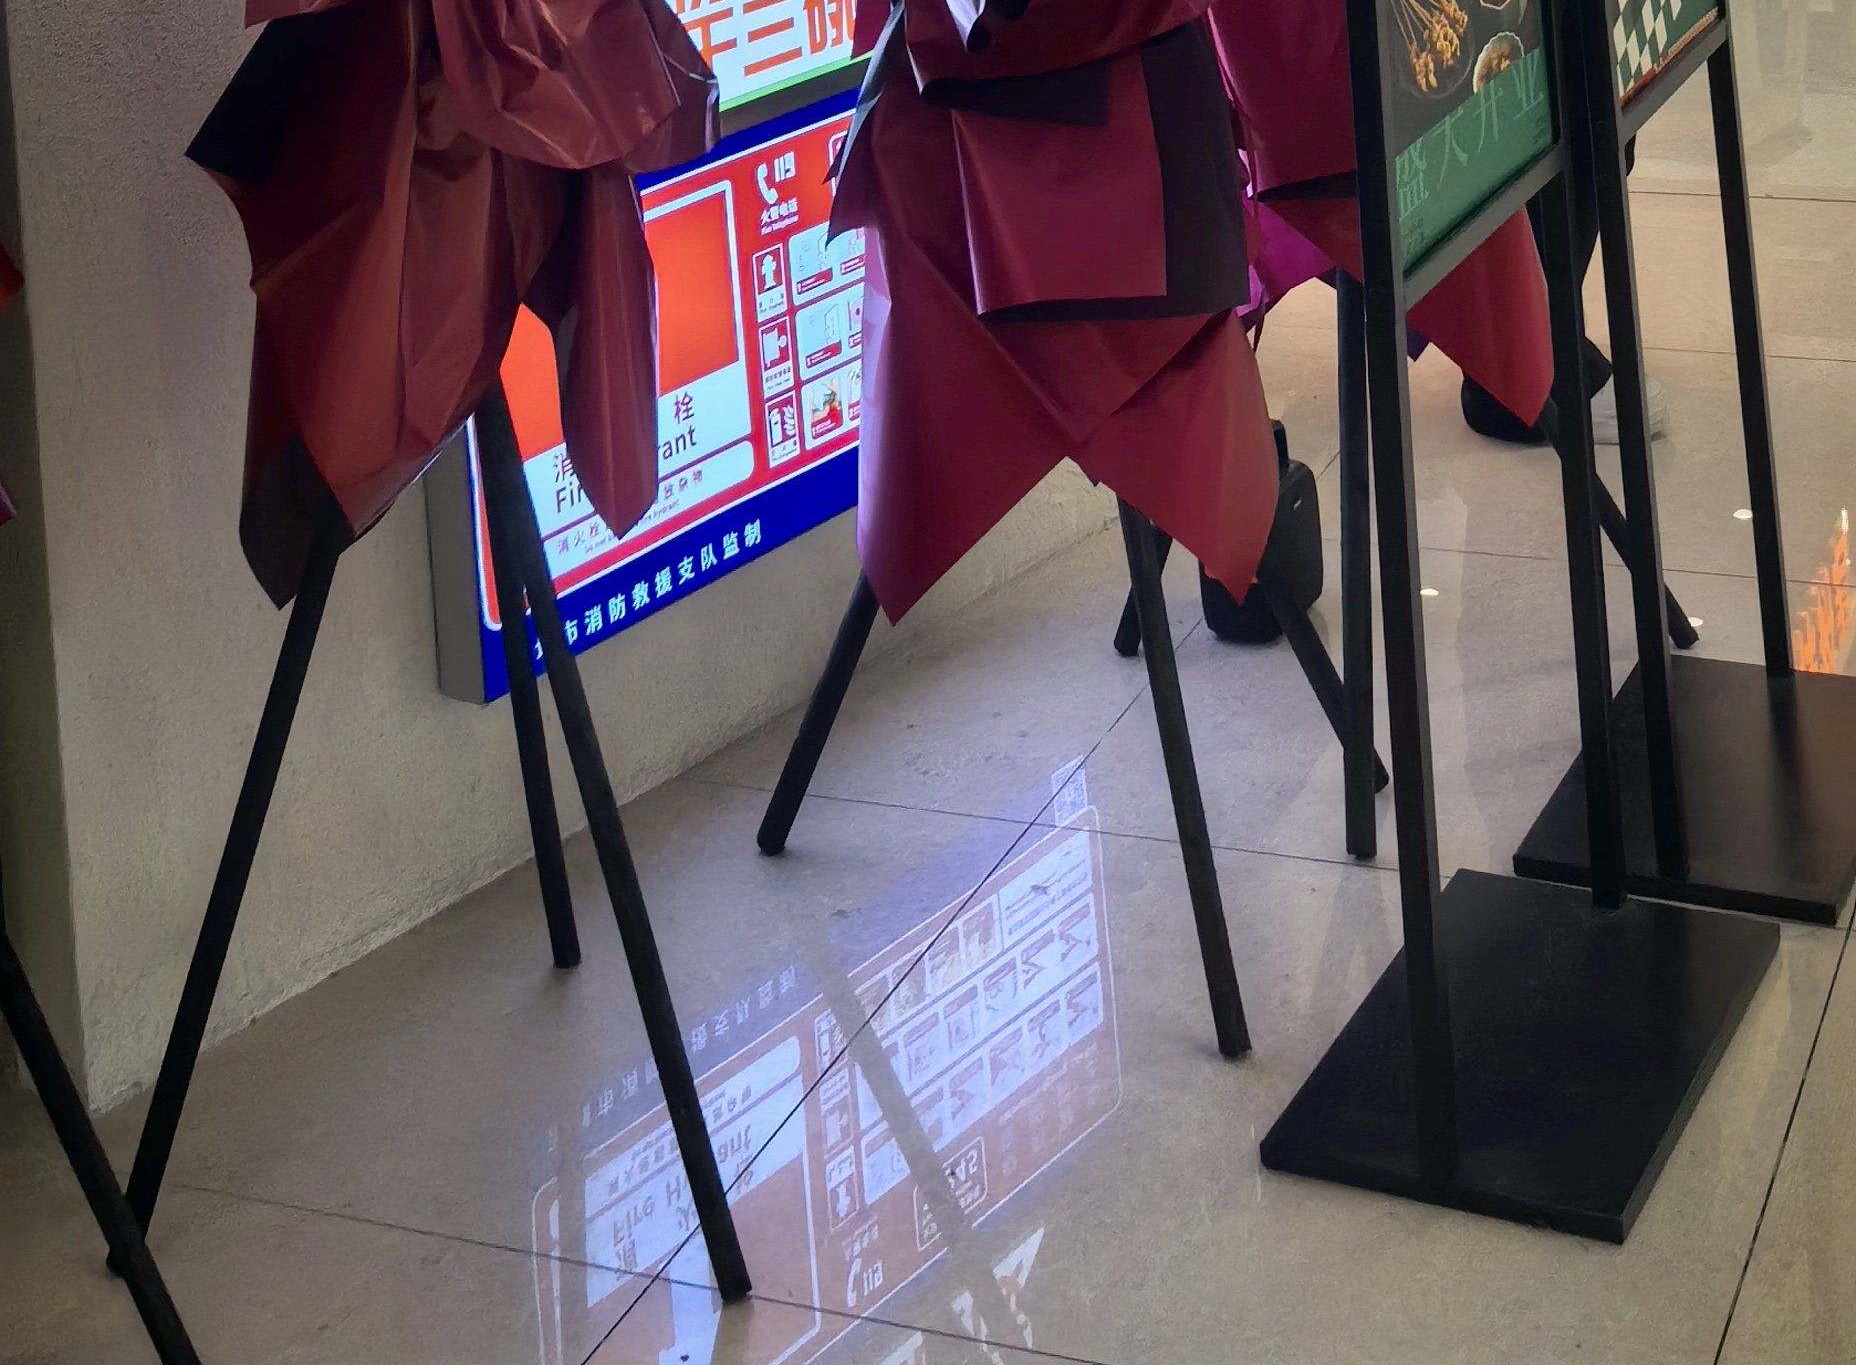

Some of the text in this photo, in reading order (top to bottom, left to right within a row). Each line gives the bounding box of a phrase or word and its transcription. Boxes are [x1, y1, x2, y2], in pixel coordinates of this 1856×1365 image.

[774, 151, 796, 183] 119
[555, 423, 699, 515] Fir rant
[534, 518, 762, 661] 市消防救援支队监制
